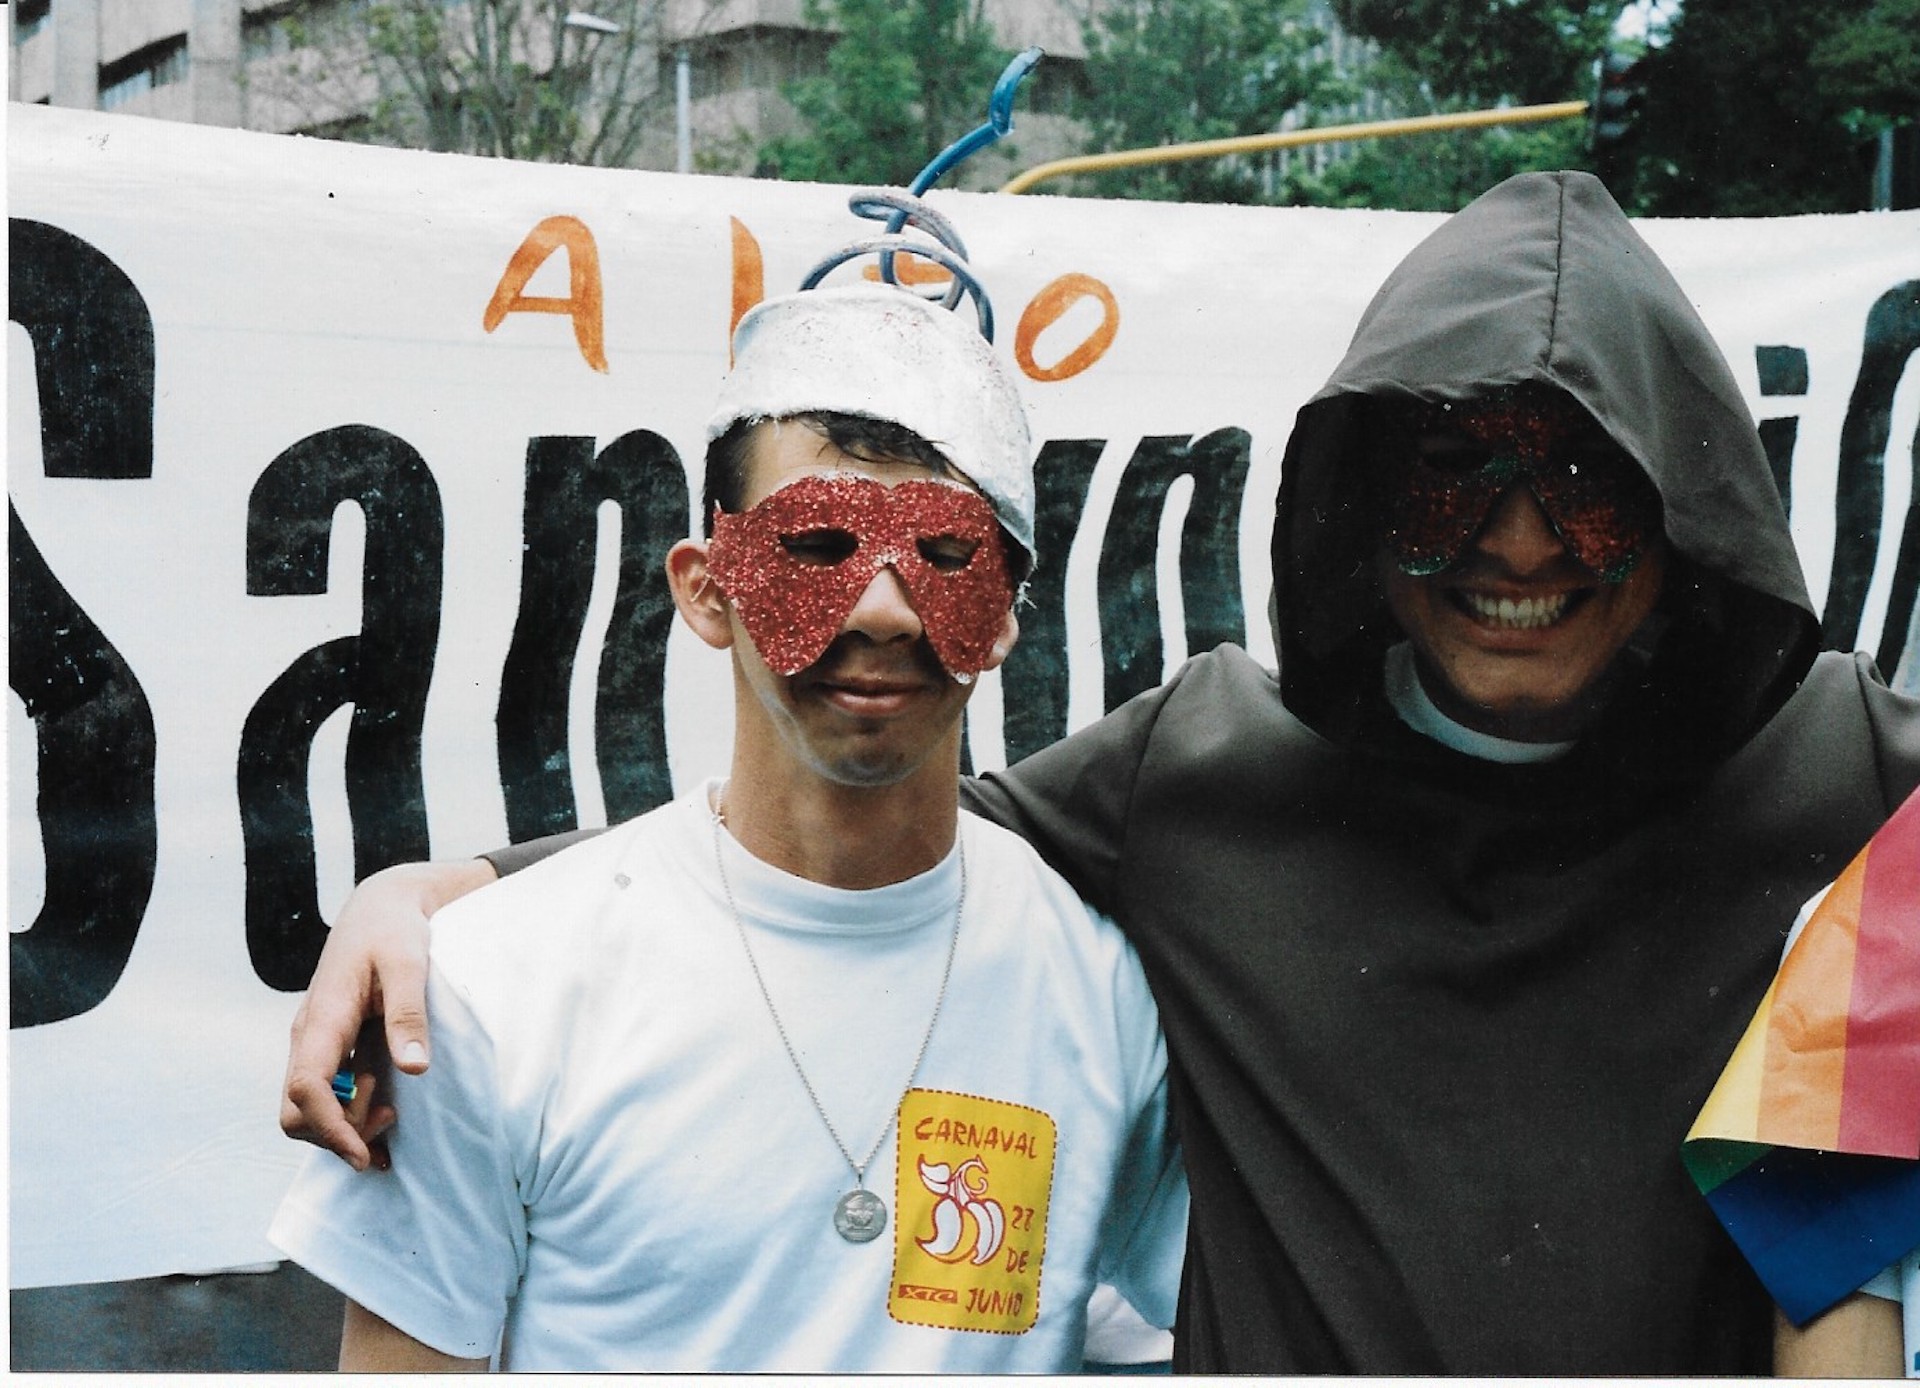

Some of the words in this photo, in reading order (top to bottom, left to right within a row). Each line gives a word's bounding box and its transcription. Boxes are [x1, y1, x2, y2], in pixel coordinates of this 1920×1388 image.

[915, 1116, 1037, 1159] CARNAVAL
[1005, 1247, 1029, 1274] DE
[964, 1287, 1024, 1317] JUNIO
